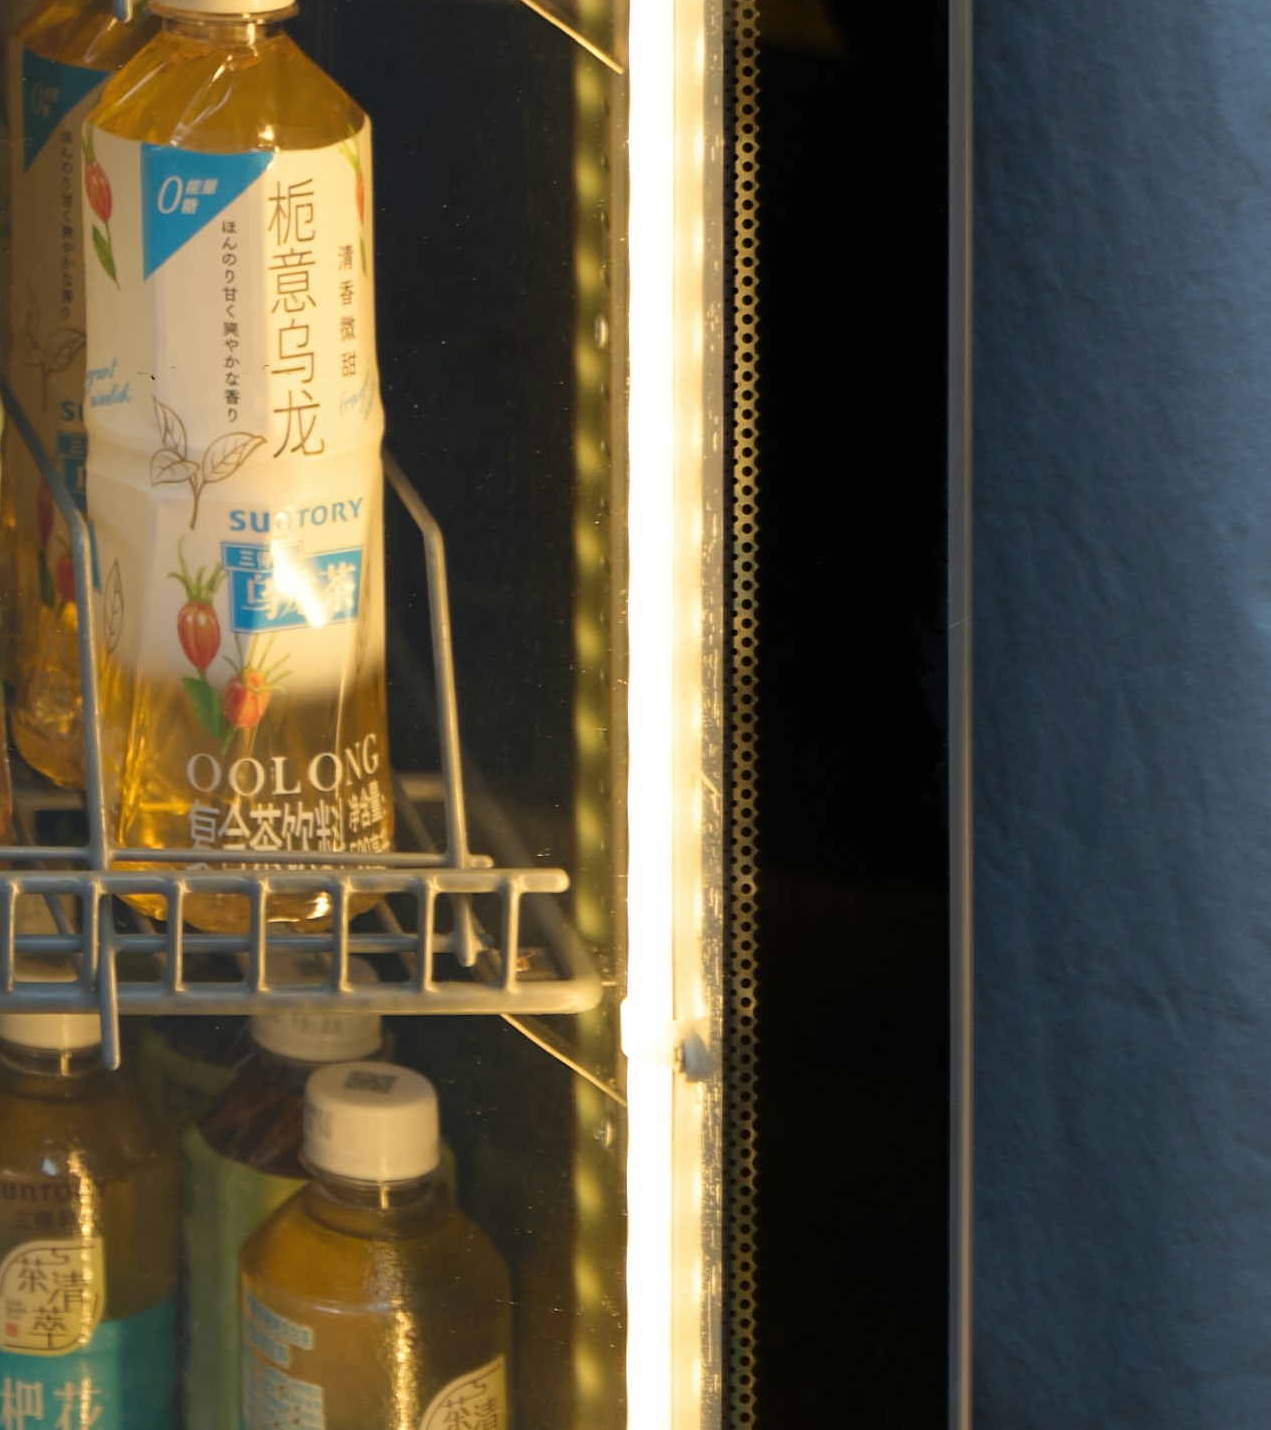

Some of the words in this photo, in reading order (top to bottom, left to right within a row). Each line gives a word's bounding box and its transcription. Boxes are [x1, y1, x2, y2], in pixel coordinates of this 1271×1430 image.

[267, 177, 326, 461] 栀意乌龙
[186, 733, 380, 800] OOLONG
